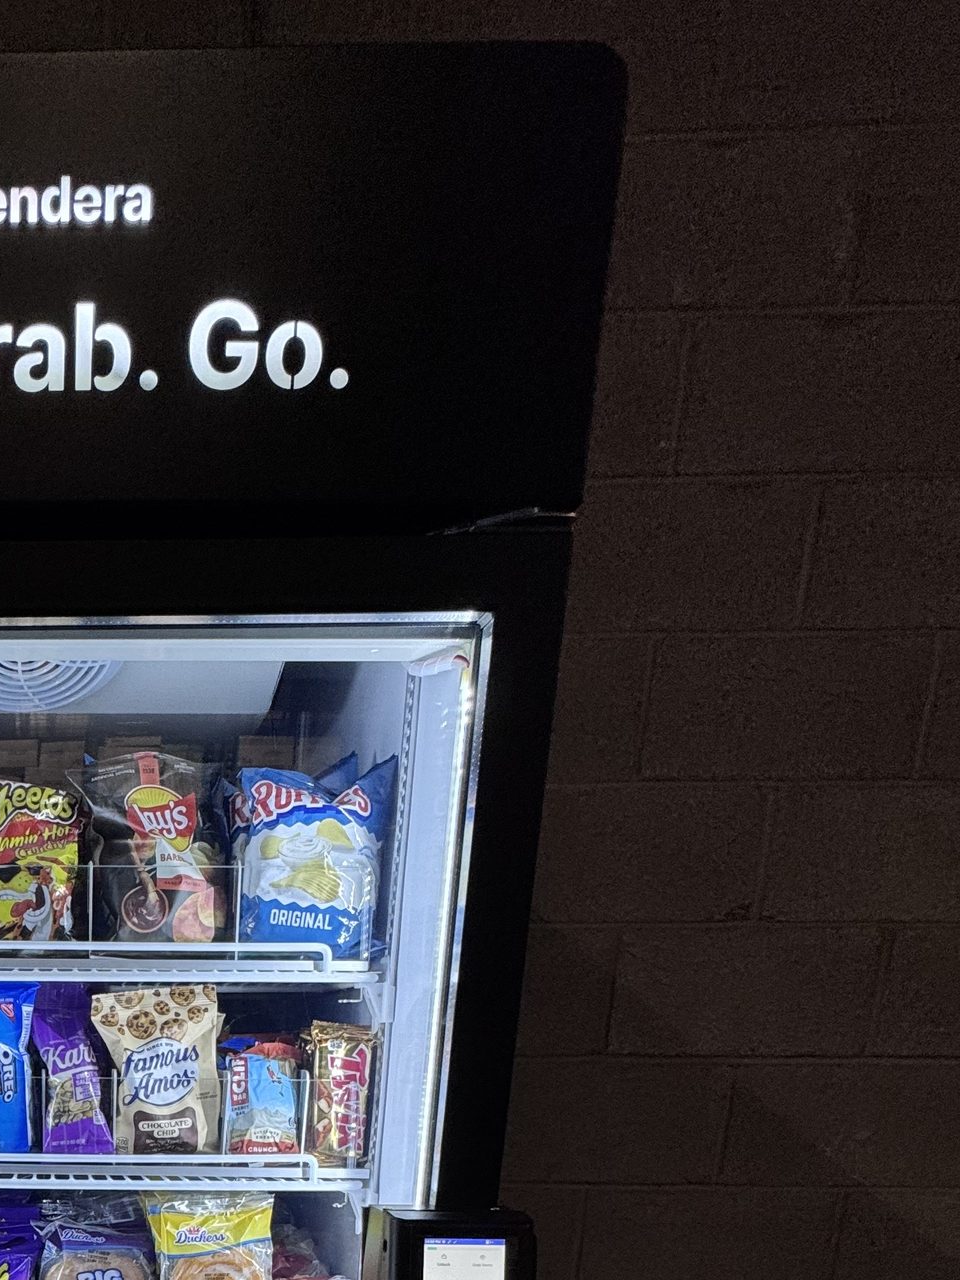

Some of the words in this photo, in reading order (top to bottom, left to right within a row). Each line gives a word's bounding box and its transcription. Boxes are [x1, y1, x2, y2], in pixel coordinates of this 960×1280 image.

[189, 297, 350, 391] Go.
[132, 800, 188, 839] Lay's
[270, 909, 333, 930] ORIGINAL
[141, 1119, 190, 1130] CHOCOLATE
[175, 1230, 226, 1244] Duchess
